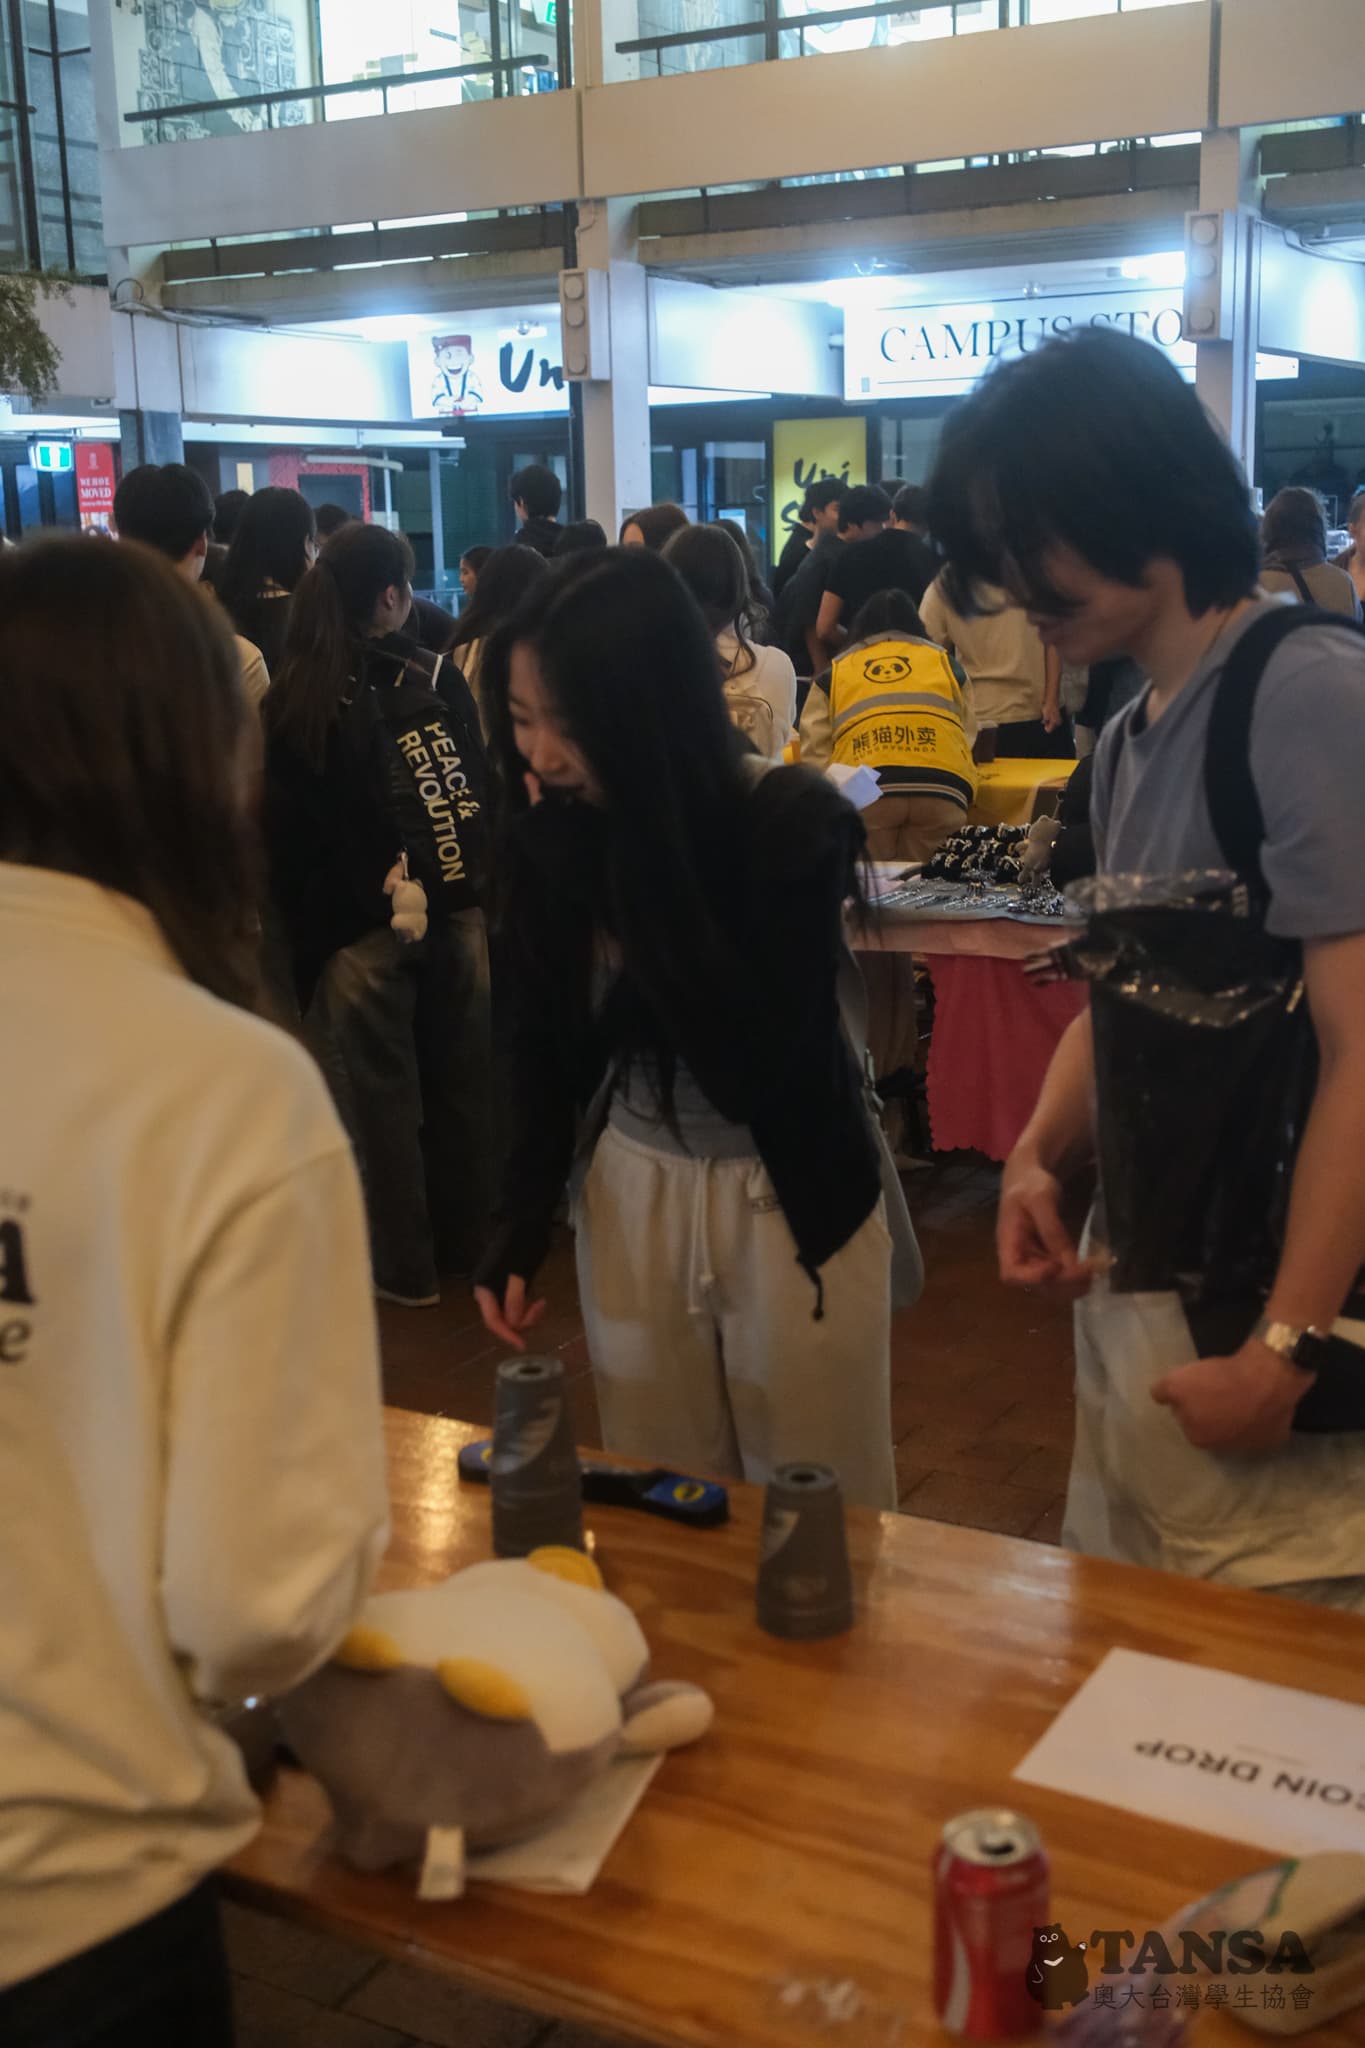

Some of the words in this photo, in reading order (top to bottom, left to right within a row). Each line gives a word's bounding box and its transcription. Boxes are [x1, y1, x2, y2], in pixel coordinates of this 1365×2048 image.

[880, 316, 1073, 362] CAMPUS
[81, 487, 112, 499] MOVED
[852, 725, 937, 756] 熊猫外卖
[396, 729, 466, 883] REVOUTION
[1134, 1740, 1261, 1783] DROP
